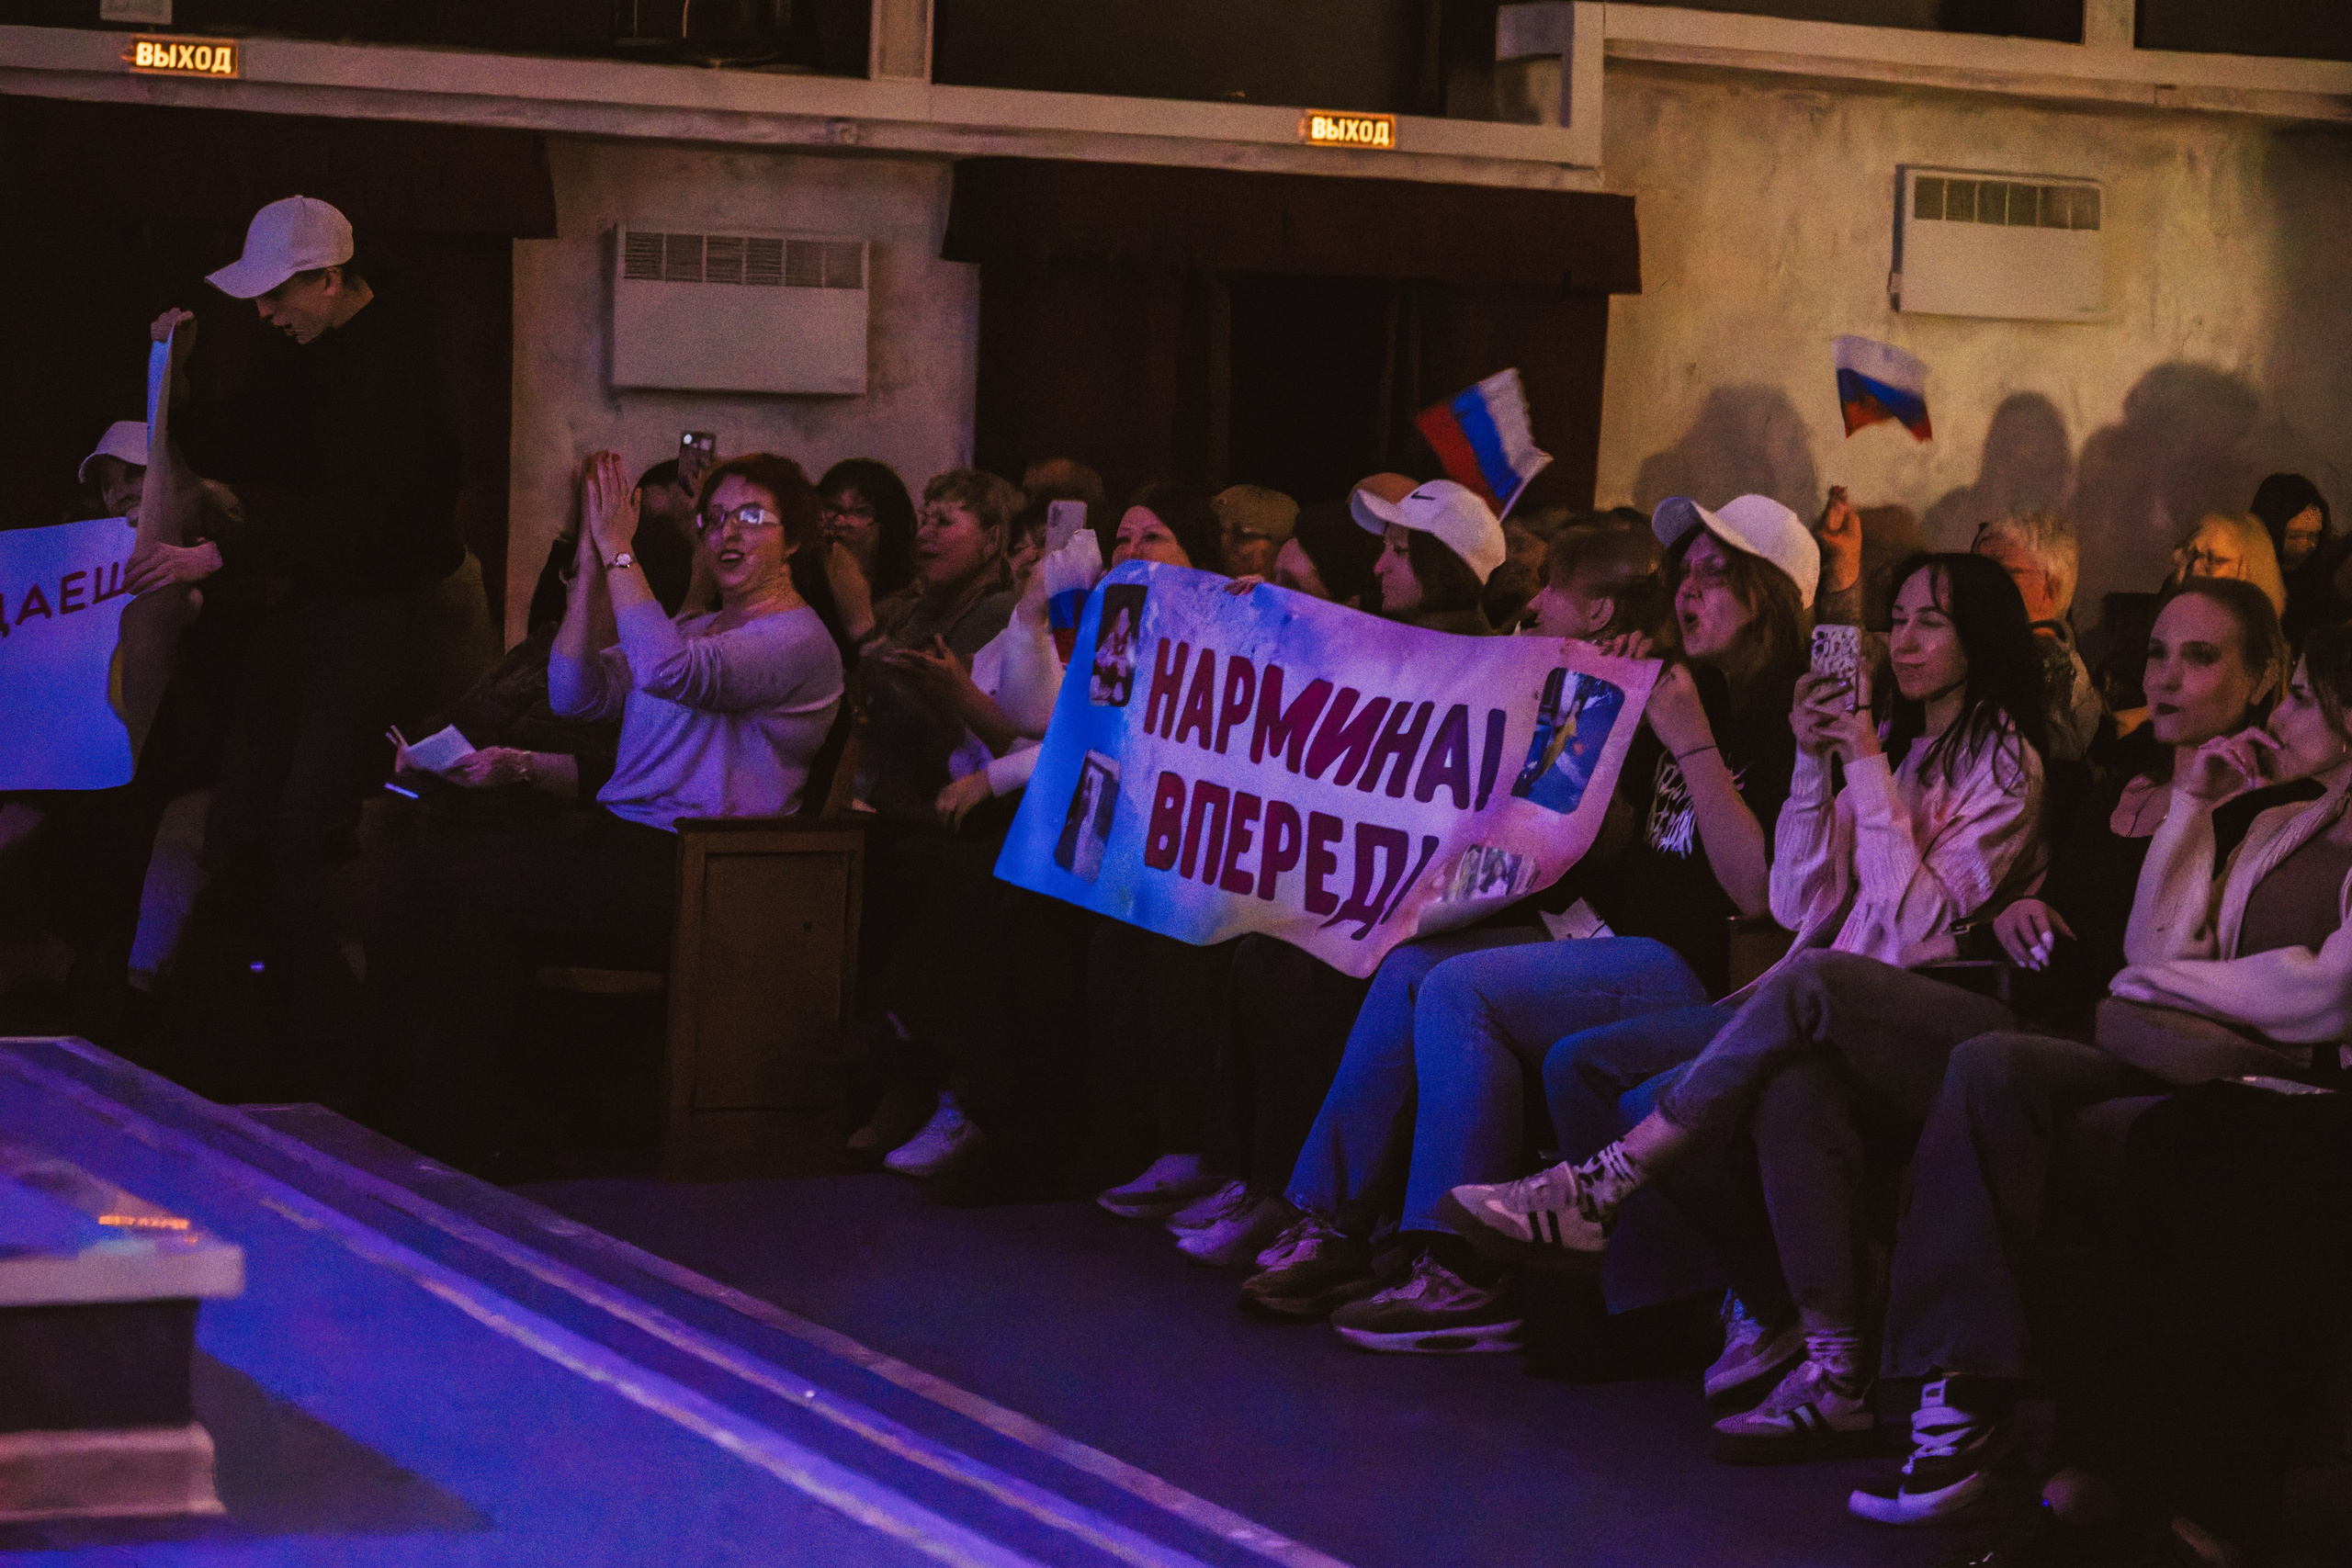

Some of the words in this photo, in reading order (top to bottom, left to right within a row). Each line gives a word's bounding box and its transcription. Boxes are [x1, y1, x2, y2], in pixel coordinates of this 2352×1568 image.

[136, 41, 232, 73] ВЫХОД
[1311, 117, 1389, 146] ВЫХОД
[0, 562, 127, 637] АЕШ
[1143, 637, 1507, 812] НАРМИНА!
[1144, 770, 1440, 941] ВПЕРЕД!
